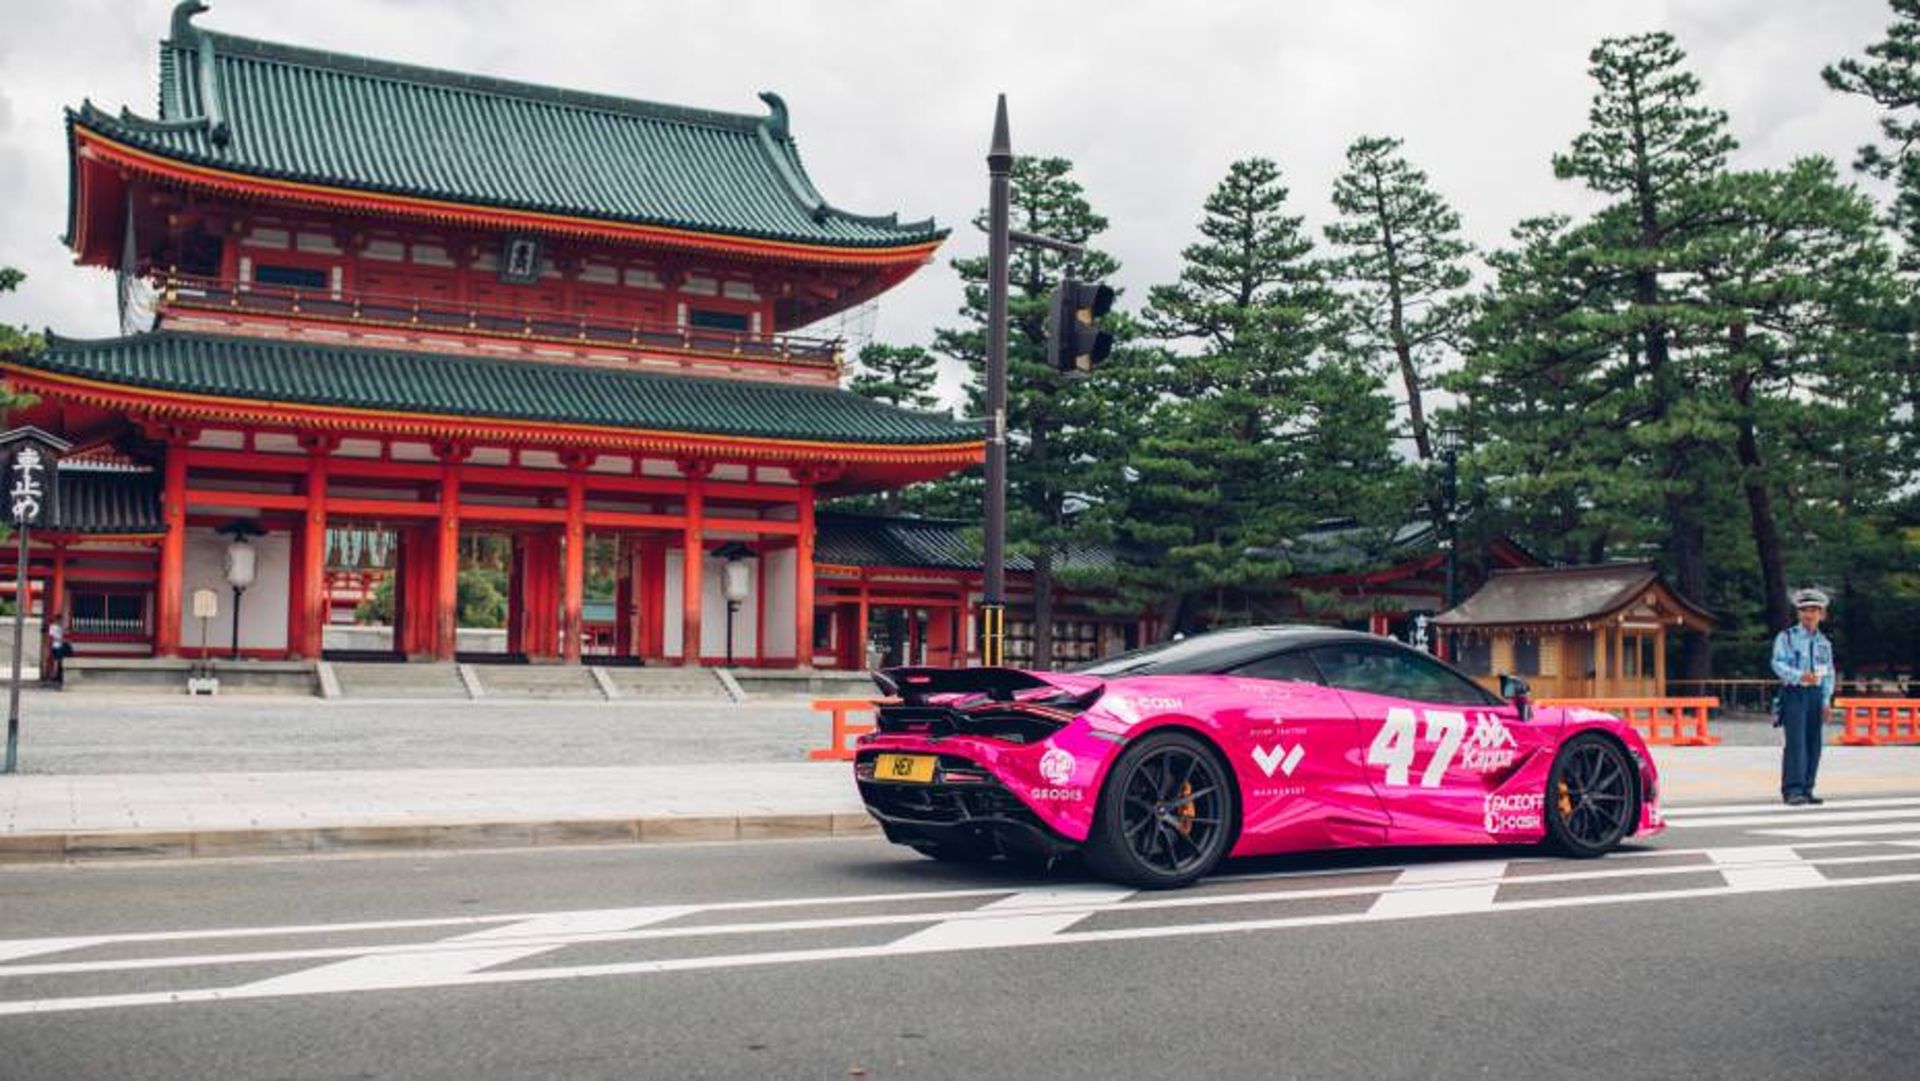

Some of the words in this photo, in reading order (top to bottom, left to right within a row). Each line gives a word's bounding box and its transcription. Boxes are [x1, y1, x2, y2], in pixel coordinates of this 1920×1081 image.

[10, 447, 44, 521] 車止め
[1367, 707, 1467, 788] 47
[1462, 741, 1514, 773] Kappa
[1031, 788, 1082, 801] GEODIS
